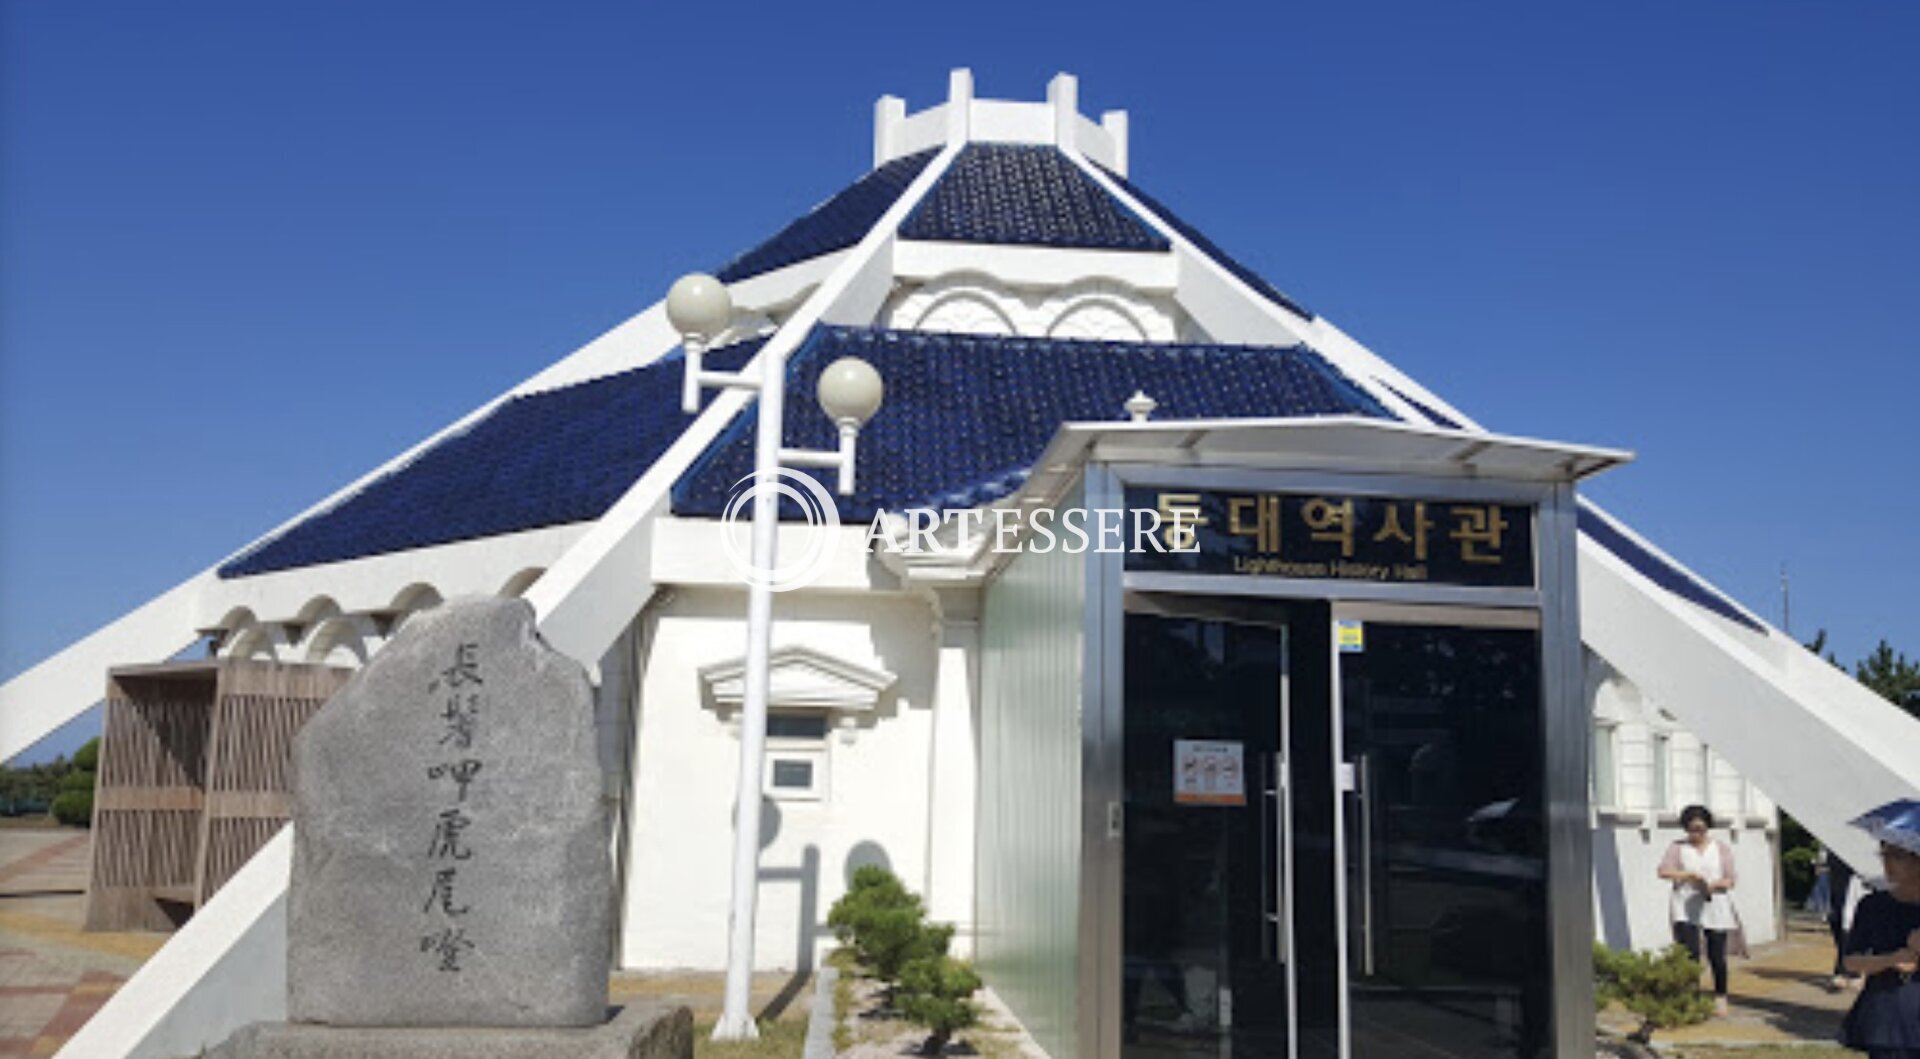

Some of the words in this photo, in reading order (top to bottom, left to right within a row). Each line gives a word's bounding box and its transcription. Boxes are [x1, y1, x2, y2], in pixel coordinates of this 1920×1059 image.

[1151, 493, 1508, 563] 등대역사관
[1234, 556, 1327, 575] Lighthouse
[1330, 559, 1389, 580] History
